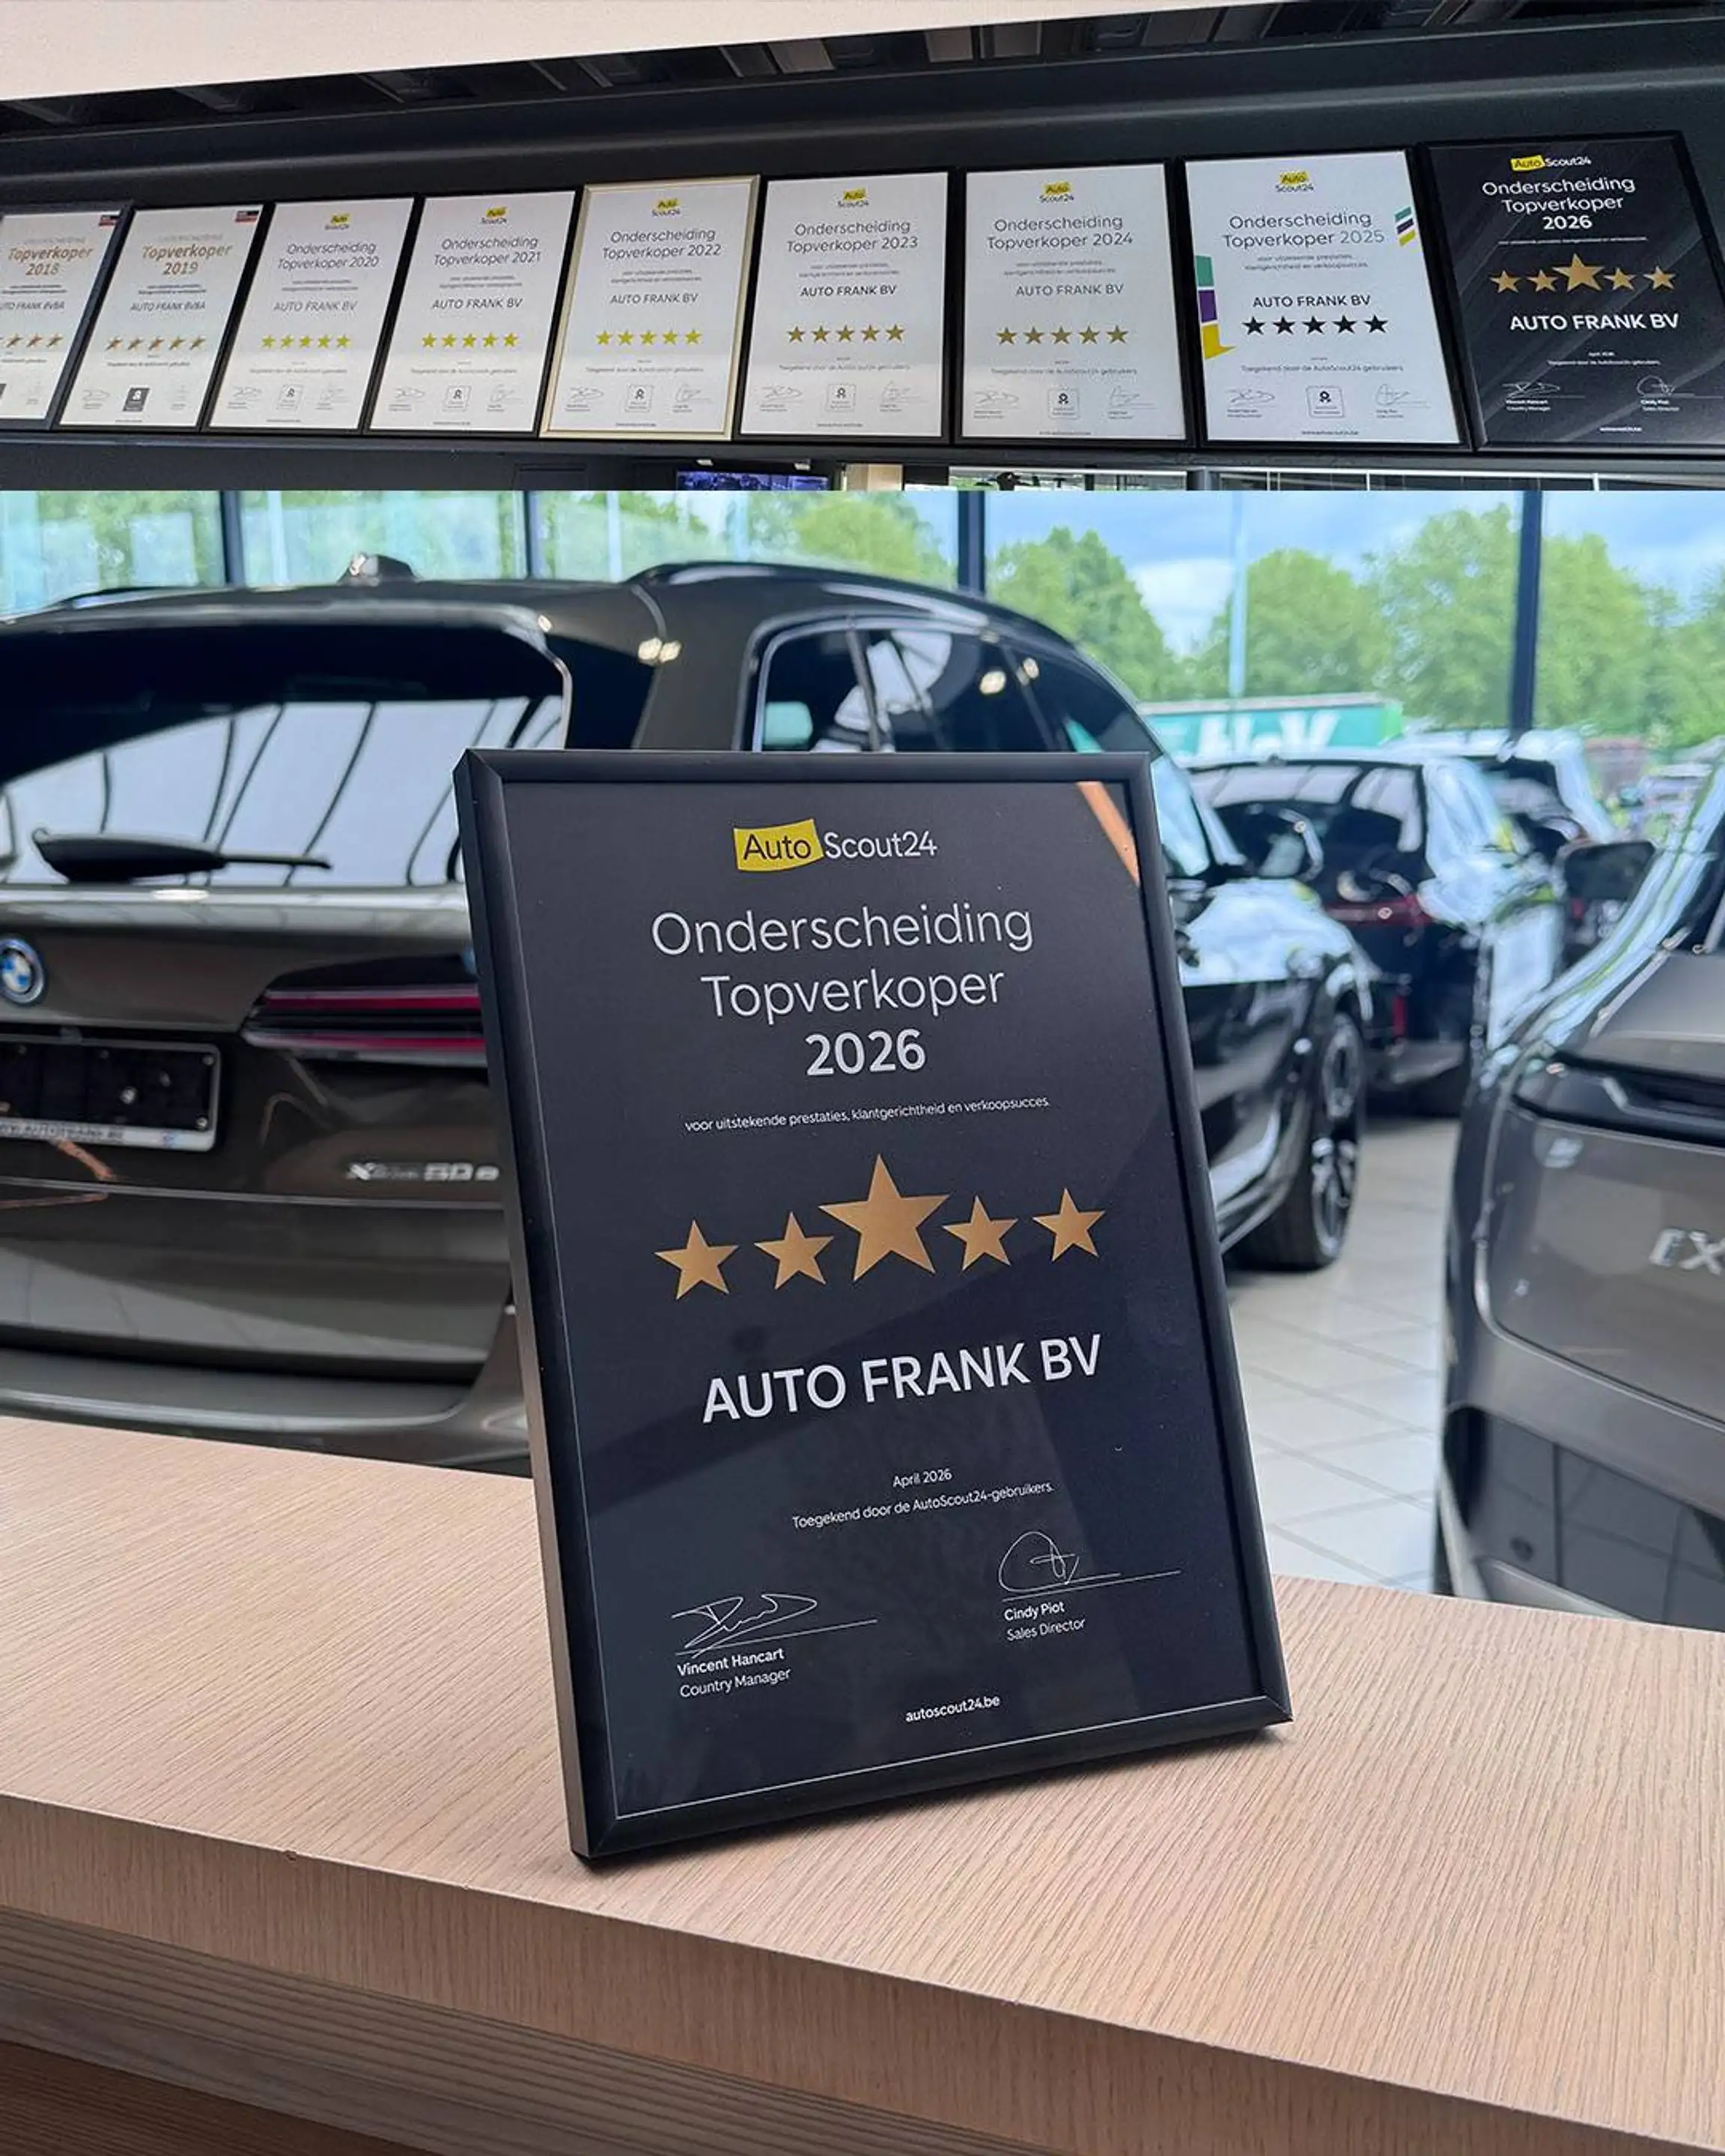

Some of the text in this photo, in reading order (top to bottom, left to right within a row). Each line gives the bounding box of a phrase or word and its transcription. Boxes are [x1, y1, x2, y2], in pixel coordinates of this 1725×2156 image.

[1513, 156, 1592, 169] Auto Scout24
[1281, 171, 1306, 183] Auto
[1275, 183, 1314, 192] Scout24
[1482, 177, 1637, 197] Onderscheiding
[1502, 196, 1624, 215] Topverkoper
[794, 220, 910, 236] Onderscheiding
[994, 216, 1123, 232] Onderscheiding
[1229, 212, 1372, 229] Onderscheiding
[1542, 215, 1593, 231] 2026
[442, 237, 538, 250] Onderscheiding
[610, 228, 717, 243] Onderscheiding
[987, 232, 1134, 252] Topverkoper 2024
[1223, 229, 1384, 249] Topverkoper 2025
[142, 243, 233, 262] Topverkoper
[287, 242, 377, 255] Onderscheiding
[603, 244, 722, 261] Topverkoper 2022
[787, 236, 919, 255] Topverkoper 2023
[8, 246, 93, 263] Topverkoper
[277, 256, 380, 270] Topverkoper 2020
[434, 252, 541, 267] Topverkoper 2021
[162, 261, 198, 275] 2019
[800, 284, 898, 296] AUTO FRANK BV
[1015, 284, 1124, 296] AUTO FRANK BV
[274, 301, 302, 311] AUTO
[432, 297, 523, 309] AUTO FRANK BV
[610, 293, 699, 305] AUTO FRANK BV
[1253, 294, 1371, 308] AUTO FRANK BV
[1509, 313, 1679, 331] AUTO FRANK BV
[742, 829, 938, 861] Auto Scout24
[651, 902, 1034, 956] Onderscheiding
[700, 968, 1005, 1026] Topverkoper
[804, 1028, 927, 1077] 2026
[684, 1120, 713, 1132] voor
[715, 1113, 787, 1130] uitstekende
[851, 1101, 945, 1123] klantgerichtheid
[948, 1103, 963, 1113] en
[702, 1333, 1101, 1423] AUTO FRANK BV
[892, 1467, 953, 1488] April 2026
[791, 1508, 860, 1529] Toegekend
[862, 1505, 892, 1520] door
[894, 1501, 911, 1514] de
[1003, 1600, 1065, 1622] Cindy Piot
[1006, 1617, 1086, 1642] Sales Director
[676, 1648, 785, 1677] Vincent Hancart
[679, 1667, 791, 1698] Country Manager
[904, 1695, 1001, 1723] autoscout24.be
